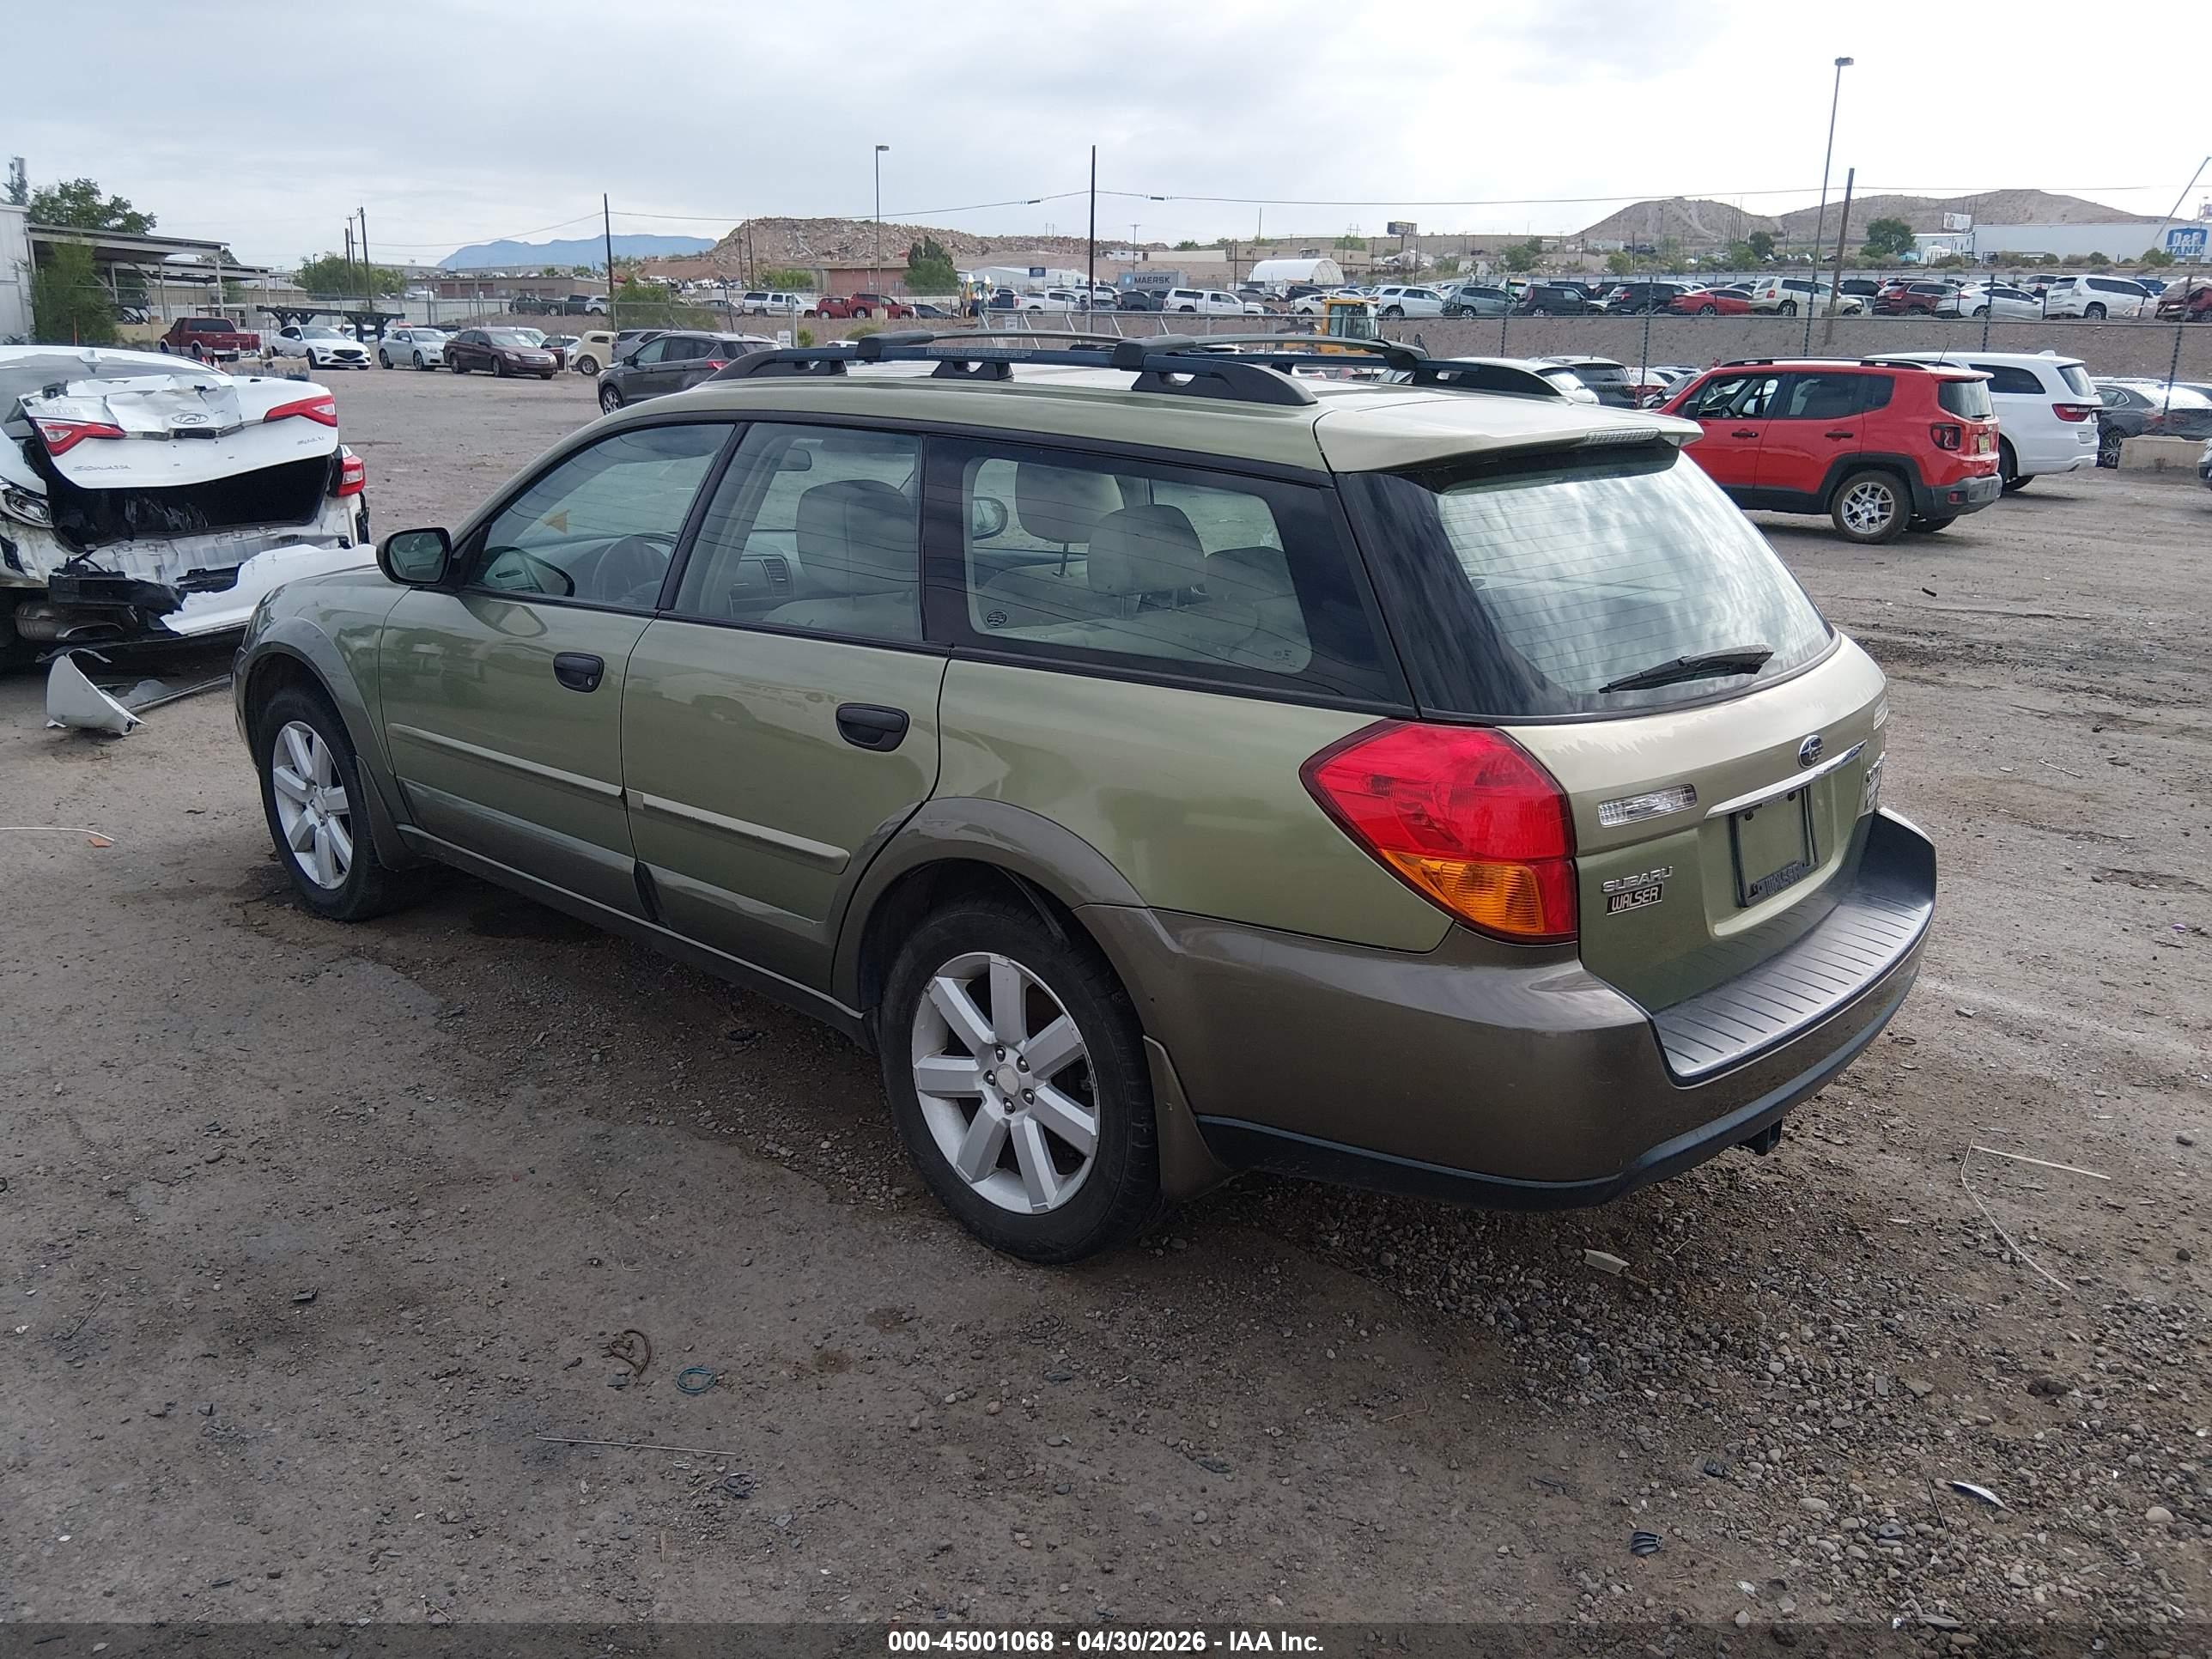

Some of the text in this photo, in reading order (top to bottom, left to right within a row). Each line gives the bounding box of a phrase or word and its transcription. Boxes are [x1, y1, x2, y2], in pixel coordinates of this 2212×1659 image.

[2166, 246, 2203, 255] TANK
[1601, 866, 1674, 893] SUBARU
[1611, 886, 1659, 911] WALSER
